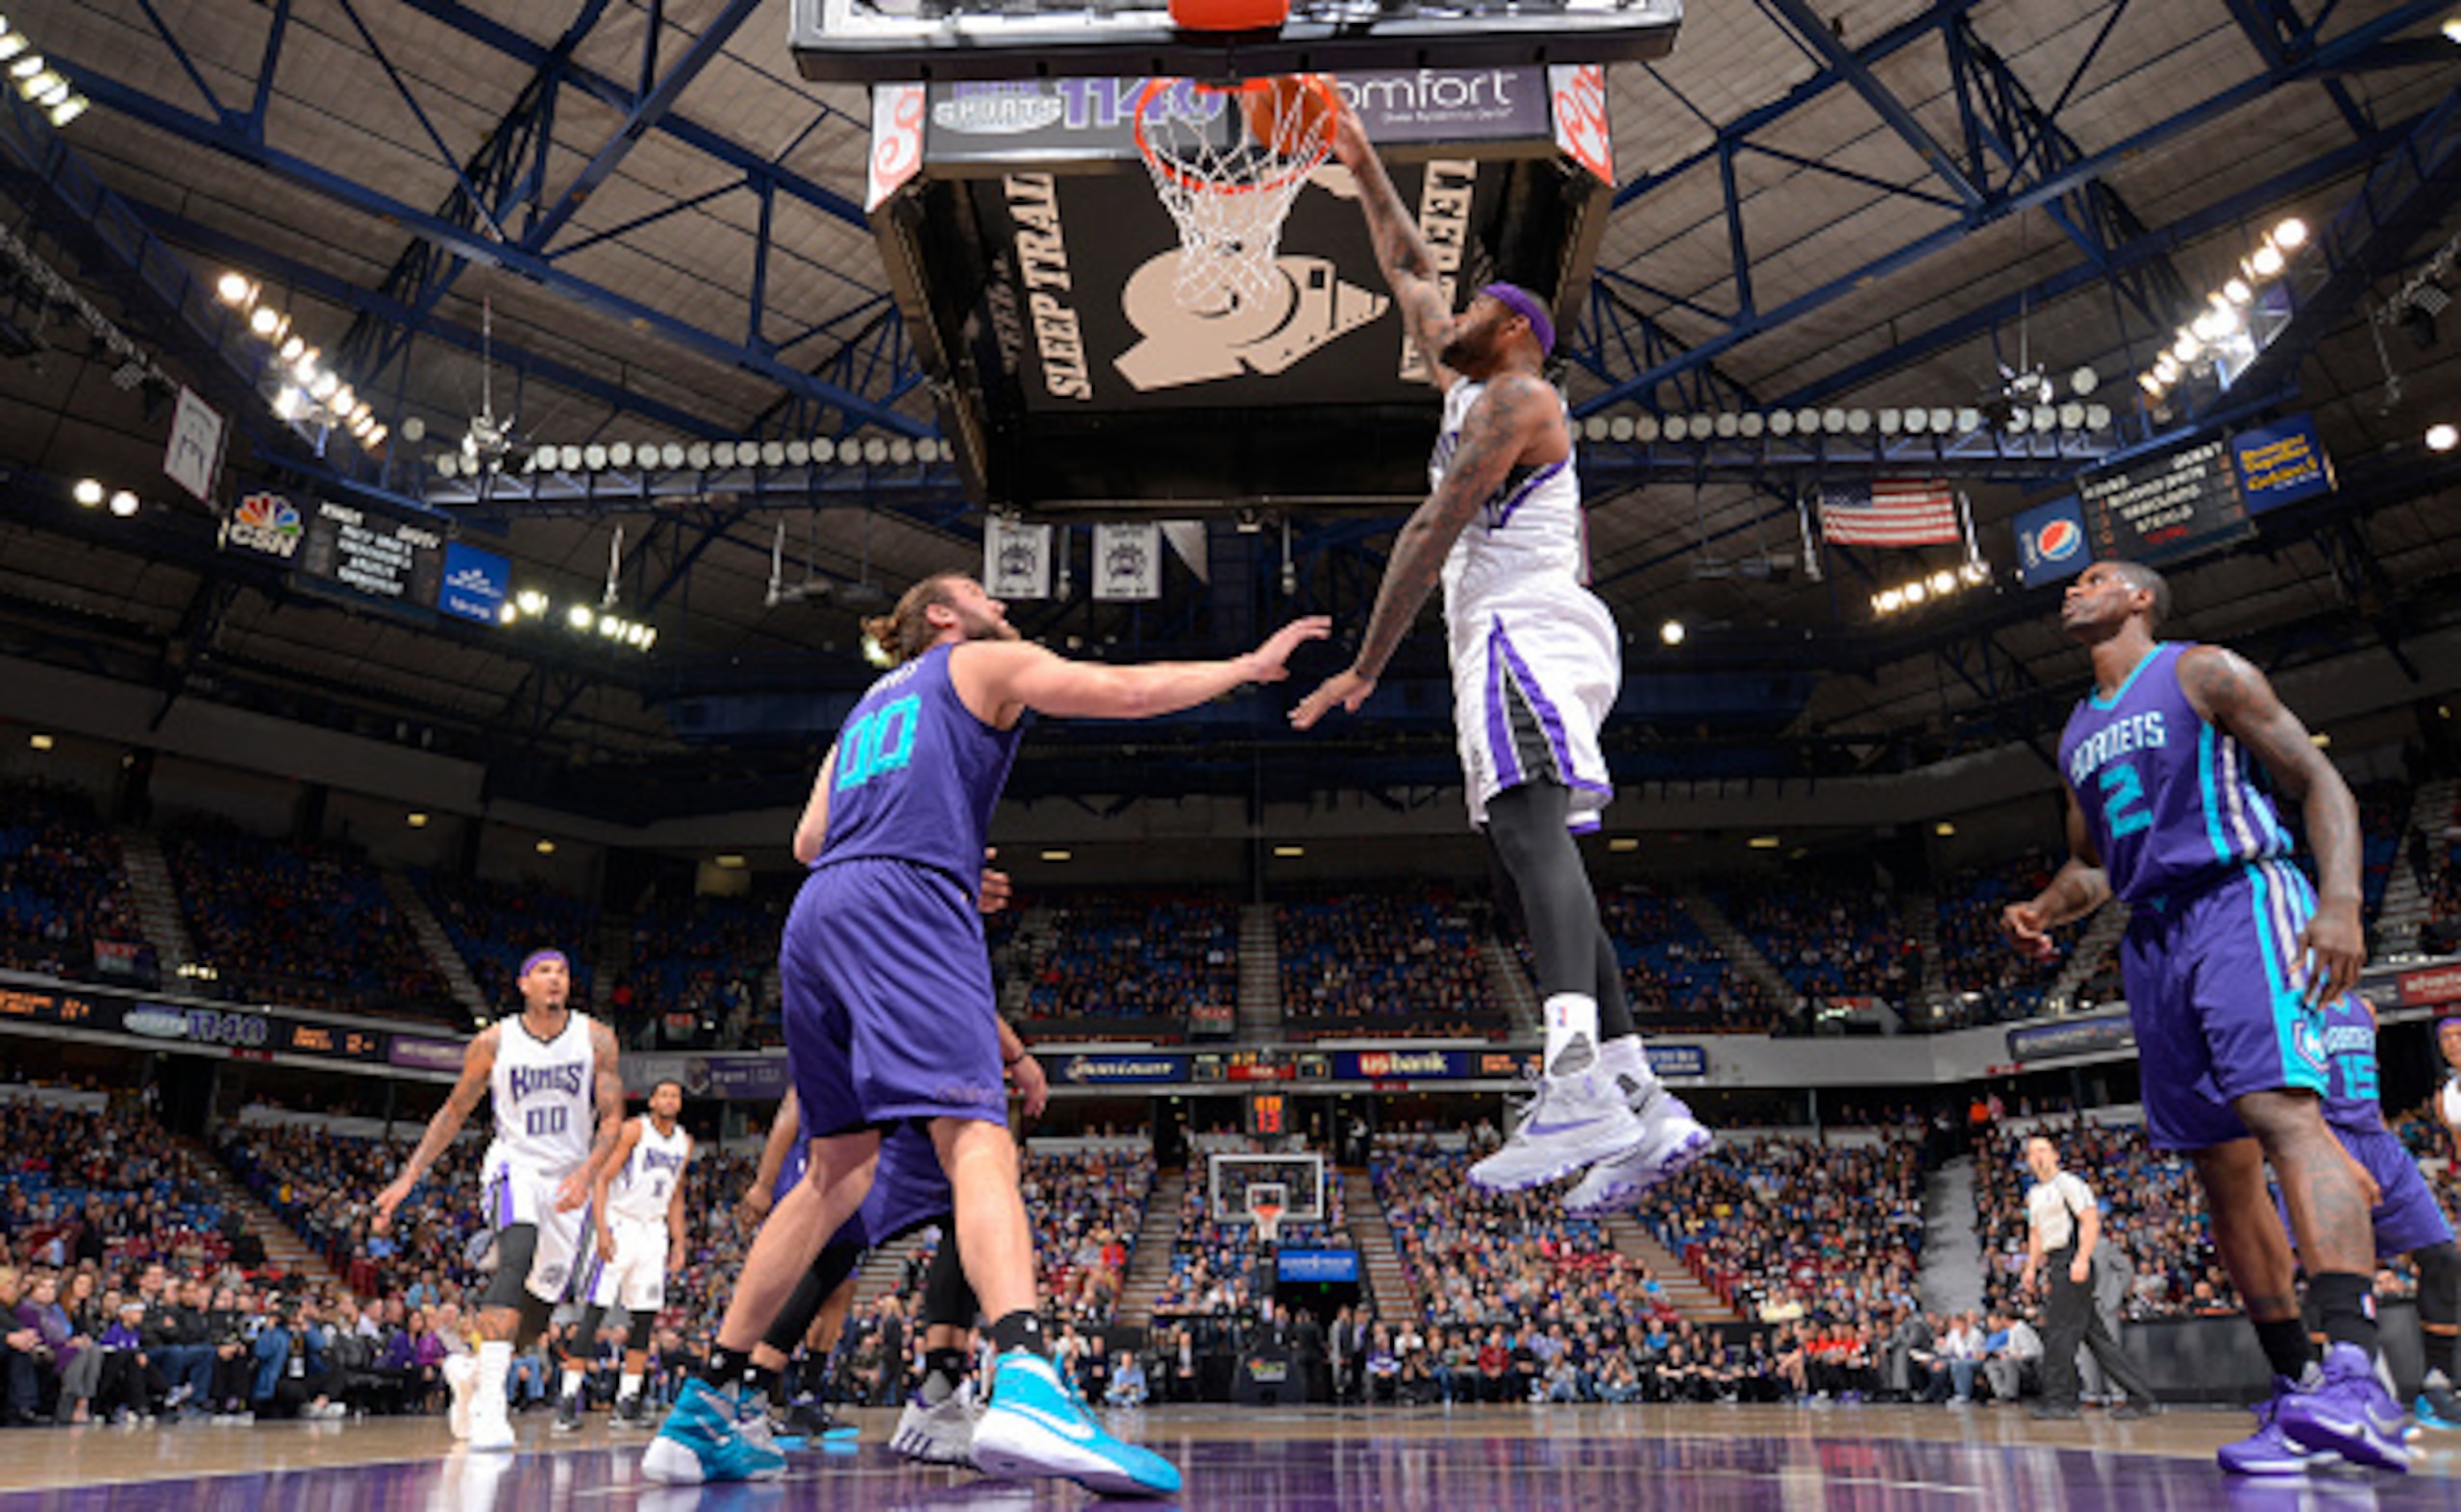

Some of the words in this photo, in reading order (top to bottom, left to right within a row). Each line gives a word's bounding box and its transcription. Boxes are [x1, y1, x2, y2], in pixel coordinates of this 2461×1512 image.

[1336, 69, 1517, 110] omfort
[1003, 173, 1071, 291] TRAI
[1030, 291, 1093, 401] SLEEP
[230, 525, 301, 558] CSN
[836, 692, 921, 792] 00
[2070, 710, 2168, 788] HORNETS
[2099, 762, 2153, 839] 2
[509, 1061, 584, 1104] KINGS
[2336, 1054, 2380, 1100] 15
[526, 1105, 568, 1135] 00
